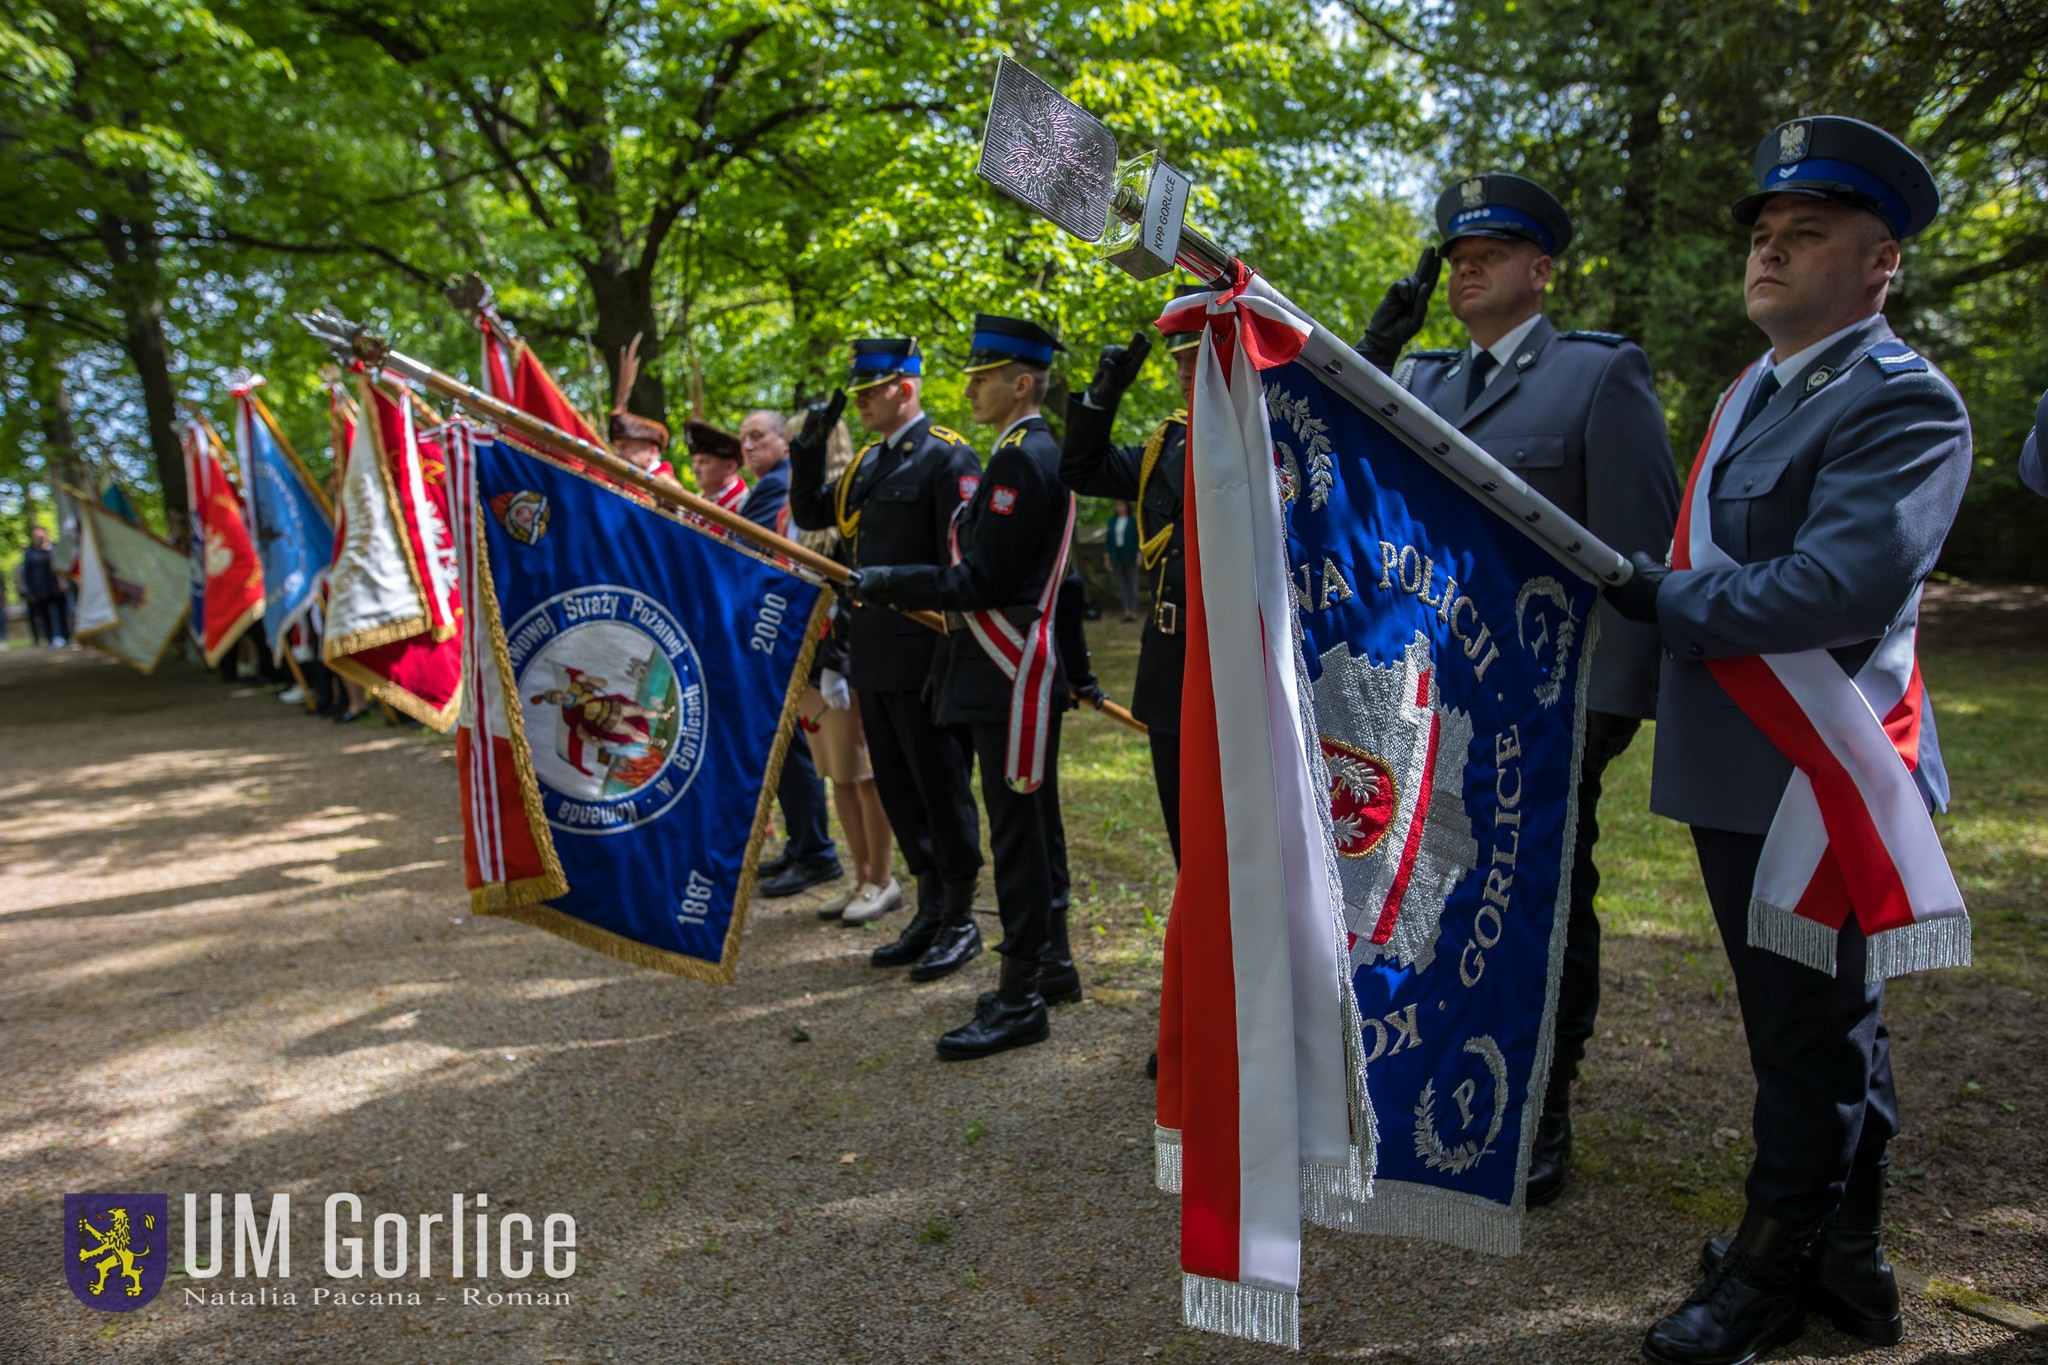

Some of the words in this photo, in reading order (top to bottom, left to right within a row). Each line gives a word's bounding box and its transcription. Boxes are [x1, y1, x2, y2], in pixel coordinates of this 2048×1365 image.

[1159, 175, 1176, 225] GORLICE
[1153, 225, 1166, 250] KPP
[561, 592, 620, 621] Straży
[629, 596, 689, 661] Pożarnej
[750, 592, 788, 656] 2000
[1378, 540, 1500, 683] POLICJI
[672, 683, 702, 772] Gorlicach
[558, 799, 639, 826] Komenda
[1459, 723, 1523, 989] GORLICE
[1451, 1078, 1475, 1130] P
